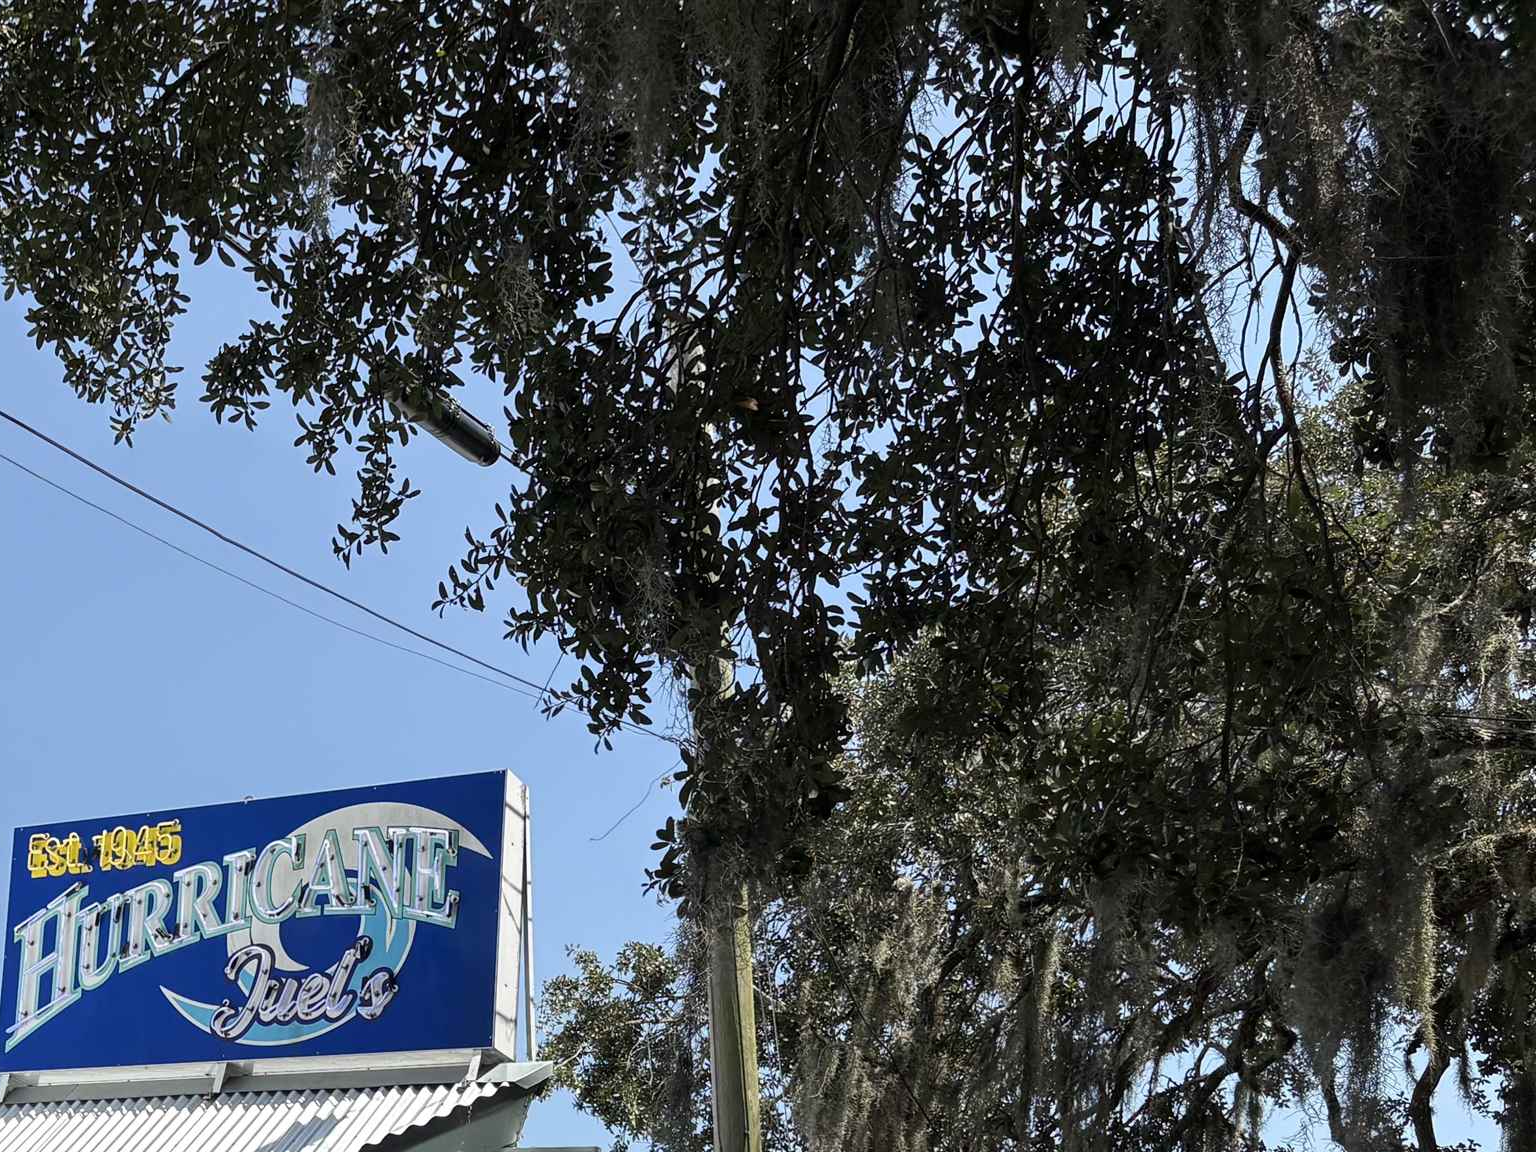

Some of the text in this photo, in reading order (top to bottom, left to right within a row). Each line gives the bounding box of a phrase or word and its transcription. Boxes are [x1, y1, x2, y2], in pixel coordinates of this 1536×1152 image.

[27, 819, 182, 879] Est. 1945
[5, 826, 460, 1053] HURRICANE
[210, 935, 399, 1039] Juel's
